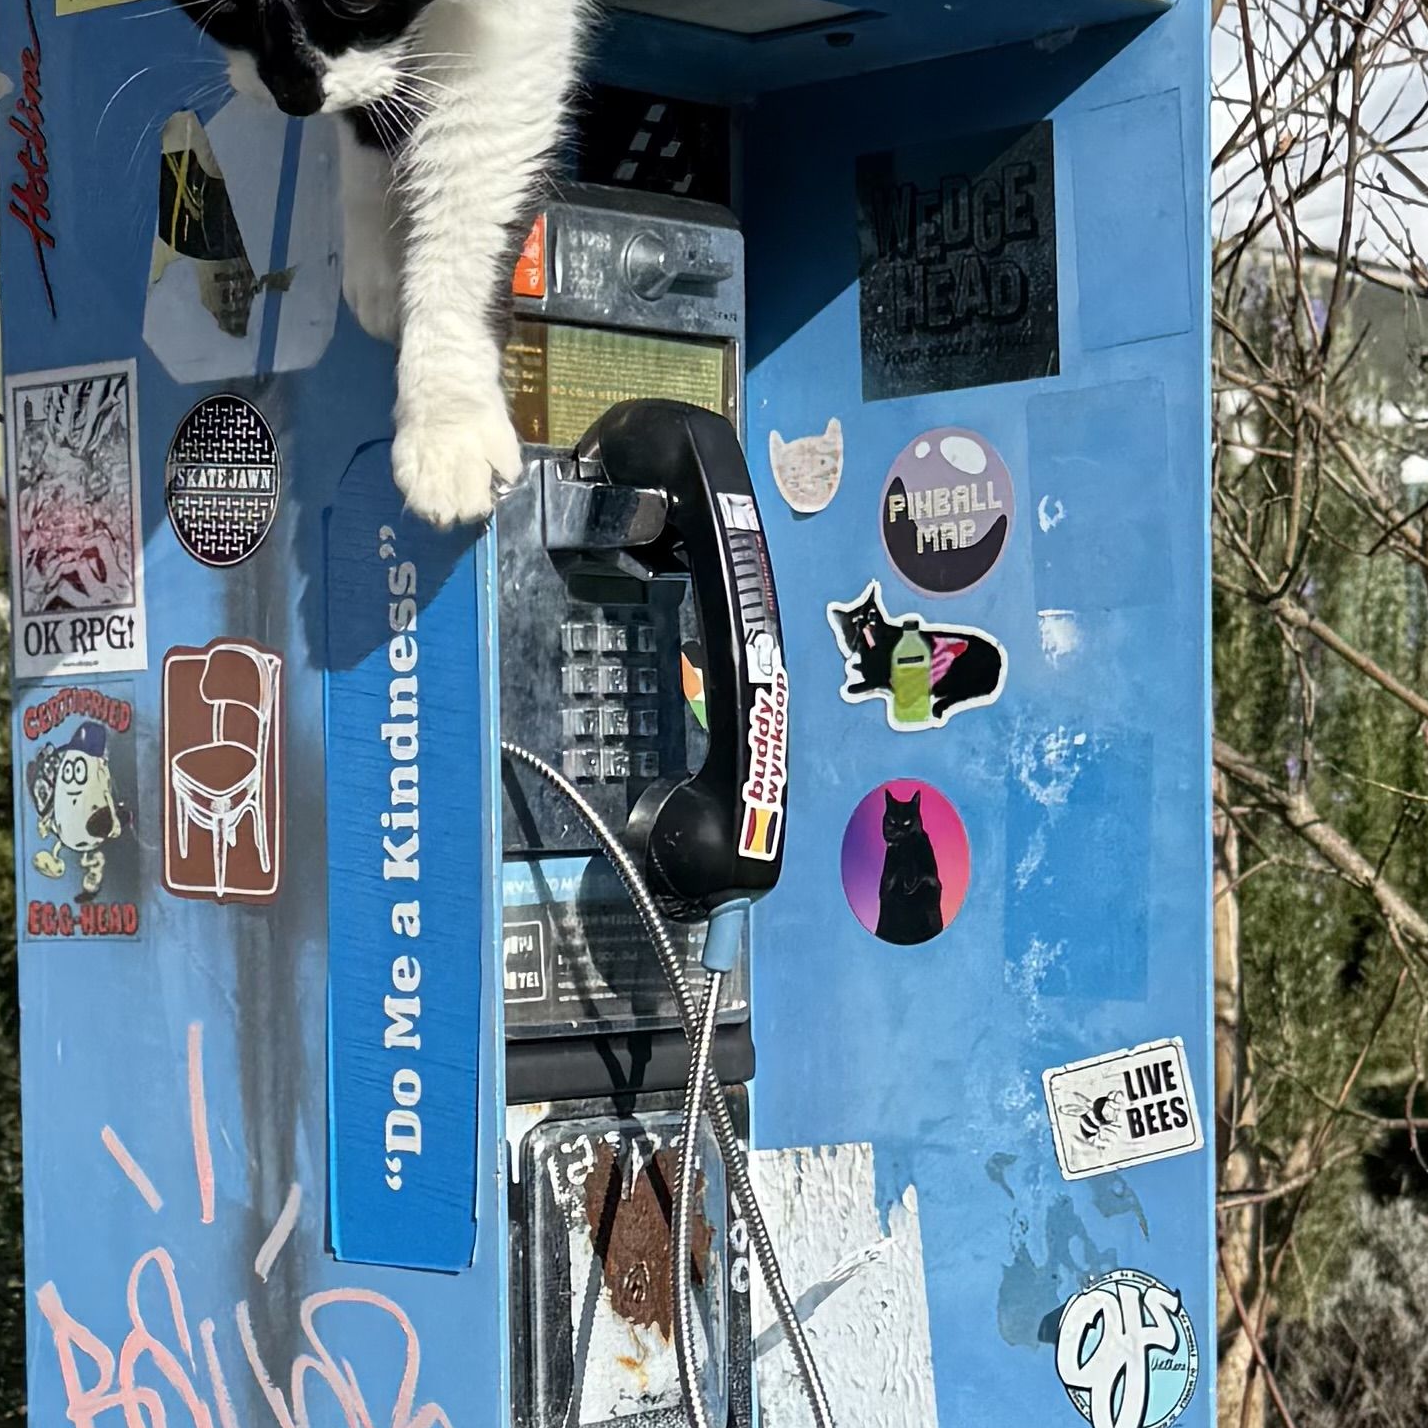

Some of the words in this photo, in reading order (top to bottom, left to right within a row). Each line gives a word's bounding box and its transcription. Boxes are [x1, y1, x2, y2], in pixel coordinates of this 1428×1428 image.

[874, 160, 1036, 262] WEDGE
[893, 252, 1030, 337] HEAD
[176, 467, 228, 489] SKATE
[229, 468, 272, 489] JAWN
[888, 481, 1003, 523] PINBALL
[916, 520, 977, 554] MAP
[24, 620, 63, 657] OK
[69, 613, 134, 655] RPG!
[748, 696, 774, 802] buddy
[767, 672, 787, 804] wynkoop
[28, 900, 139, 936] EGG-HEAD
[391, 900, 422, 938] a
[383, 955, 422, 1050] Me
[1123, 1060, 1178, 1102] LIVE
[1126, 1096, 1189, 1139] BEES
